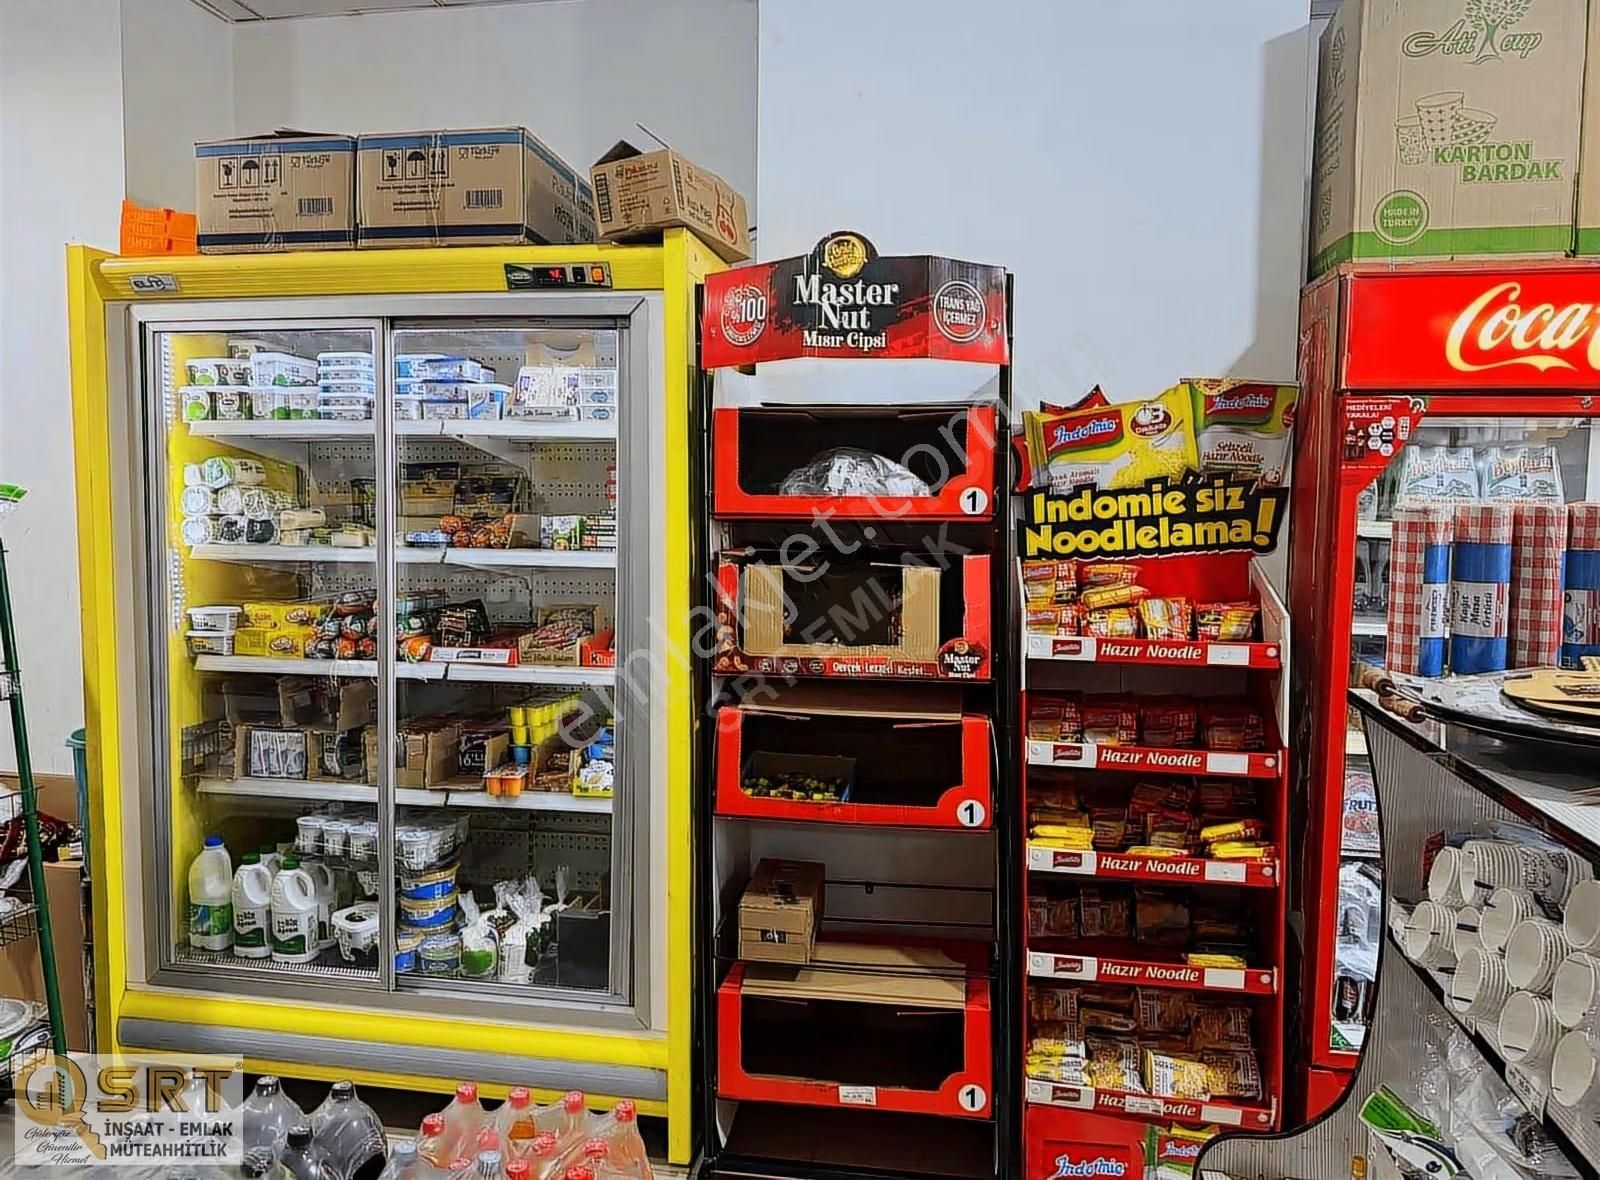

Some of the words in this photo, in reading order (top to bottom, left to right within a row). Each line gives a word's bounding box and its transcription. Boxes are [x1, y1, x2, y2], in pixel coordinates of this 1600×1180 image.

[1434, 143, 1532, 164] KARTON
[1462, 161, 1560, 182] BARDAK
[1382, 217, 1421, 229] TURKEY
[1383, 207, 1408, 218] MADE
[1409, 207, 1420, 218] IN
[793, 275, 899, 306] Master
[939, 296, 964, 310] TRANS
[818, 303, 871, 330] Nut
[803, 331, 844, 348] Mısır
[847, 331, 887, 351] Cipsi
[1053, 417, 1120, 444] Indomie
[966, 490, 979, 512] 1
[1025, 497, 1272, 556] Noodlelama!
[1100, 642, 1142, 659] Hazır
[1146, 644, 1203, 660] Noodle
[1100, 751, 1143, 767] Hazır
[1146, 752, 1203, 767] Noodle
[964, 803, 975, 824] 1
[1100, 856, 1142, 872] Hazır
[1146, 859, 1201, 876] Noodle
[1100, 961, 1142, 977] Hazır
[1146, 965, 1200, 982] Noodle
[965, 1088, 976, 1108] 1
[1099, 1094, 1126, 1108] Haz
[1163, 1103, 1197, 1117] odle
[1056, 1154, 1127, 1178] Indomie
